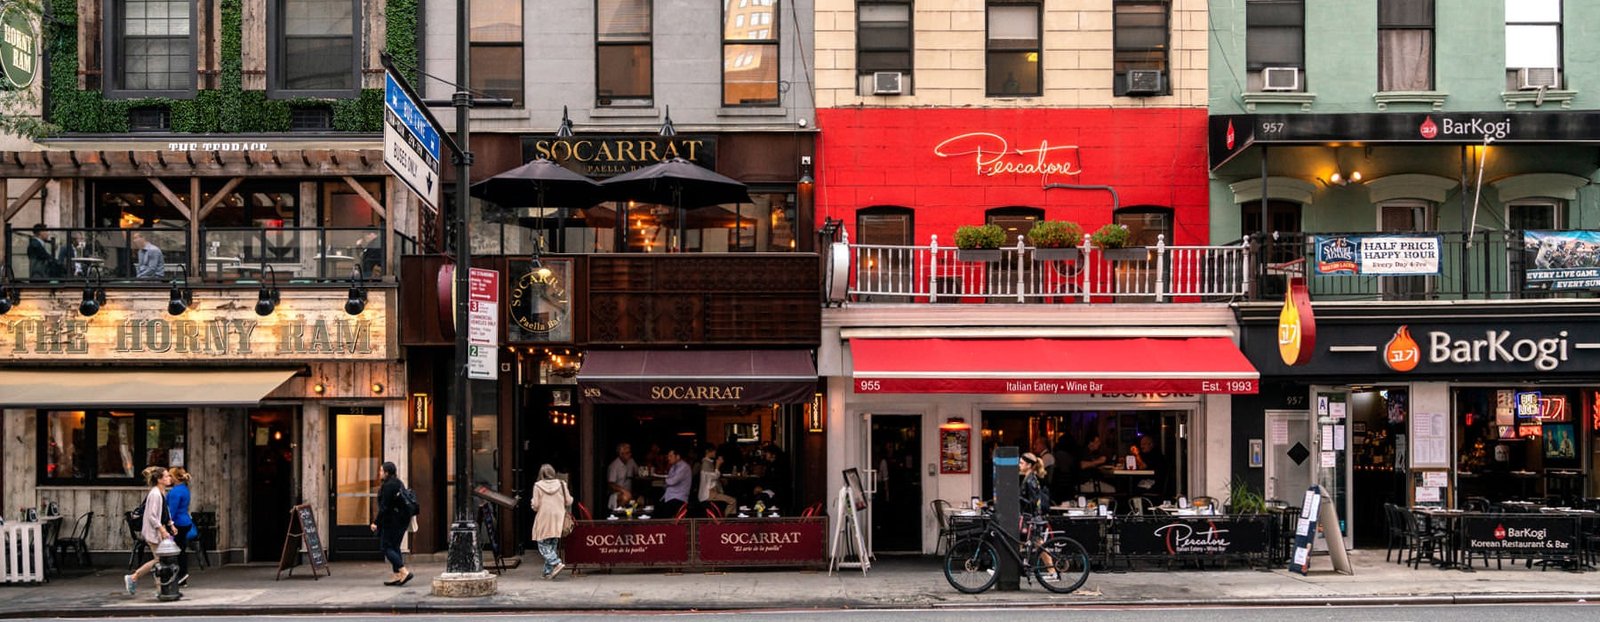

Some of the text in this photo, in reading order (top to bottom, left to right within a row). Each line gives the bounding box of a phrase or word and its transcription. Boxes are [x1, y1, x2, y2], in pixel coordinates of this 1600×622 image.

[4, 23, 32, 54] HORNY
[13, 48, 31, 74] RAM
[403, 101, 426, 139] BUS LANE
[1263, 122, 1284, 133] 957
[1443, 118, 1510, 138] BarKogi
[535, 140, 703, 161] SOCARRAT
[934, 132, 1081, 177] Pescatore
[1364, 242, 1434, 250] HALF PRICE
[1364, 251, 1435, 259] HAPPY HOUR
[1526, 271, 1554, 280] EVERY
[471, 301, 477, 311] 3
[520, 316, 561, 330] Paella Bar
[8, 318, 372, 354] THE HORNY RAM
[1280, 320, 1300, 348] 고기
[471, 346, 477, 356] 2
[1390, 347, 1418, 363] 고기
[1429, 331, 1568, 371] BarKogi
[651, 386, 743, 399] SOCARRAT
[861, 381, 880, 391] 955
[1006, 381, 1103, 393] Italian Eatery Wine Bar
[1202, 381, 1251, 391] Est. 1993
[1319, 399, 1326, 410] A
[586, 533, 666, 546] SOCARRAT
[720, 532, 801, 545] SOCARRAT
[1154, 523, 1230, 547] Pescatore
[1508, 528, 1546, 539] BarKogi
[1471, 540, 1569, 548] Korean Restaurant & Bar
